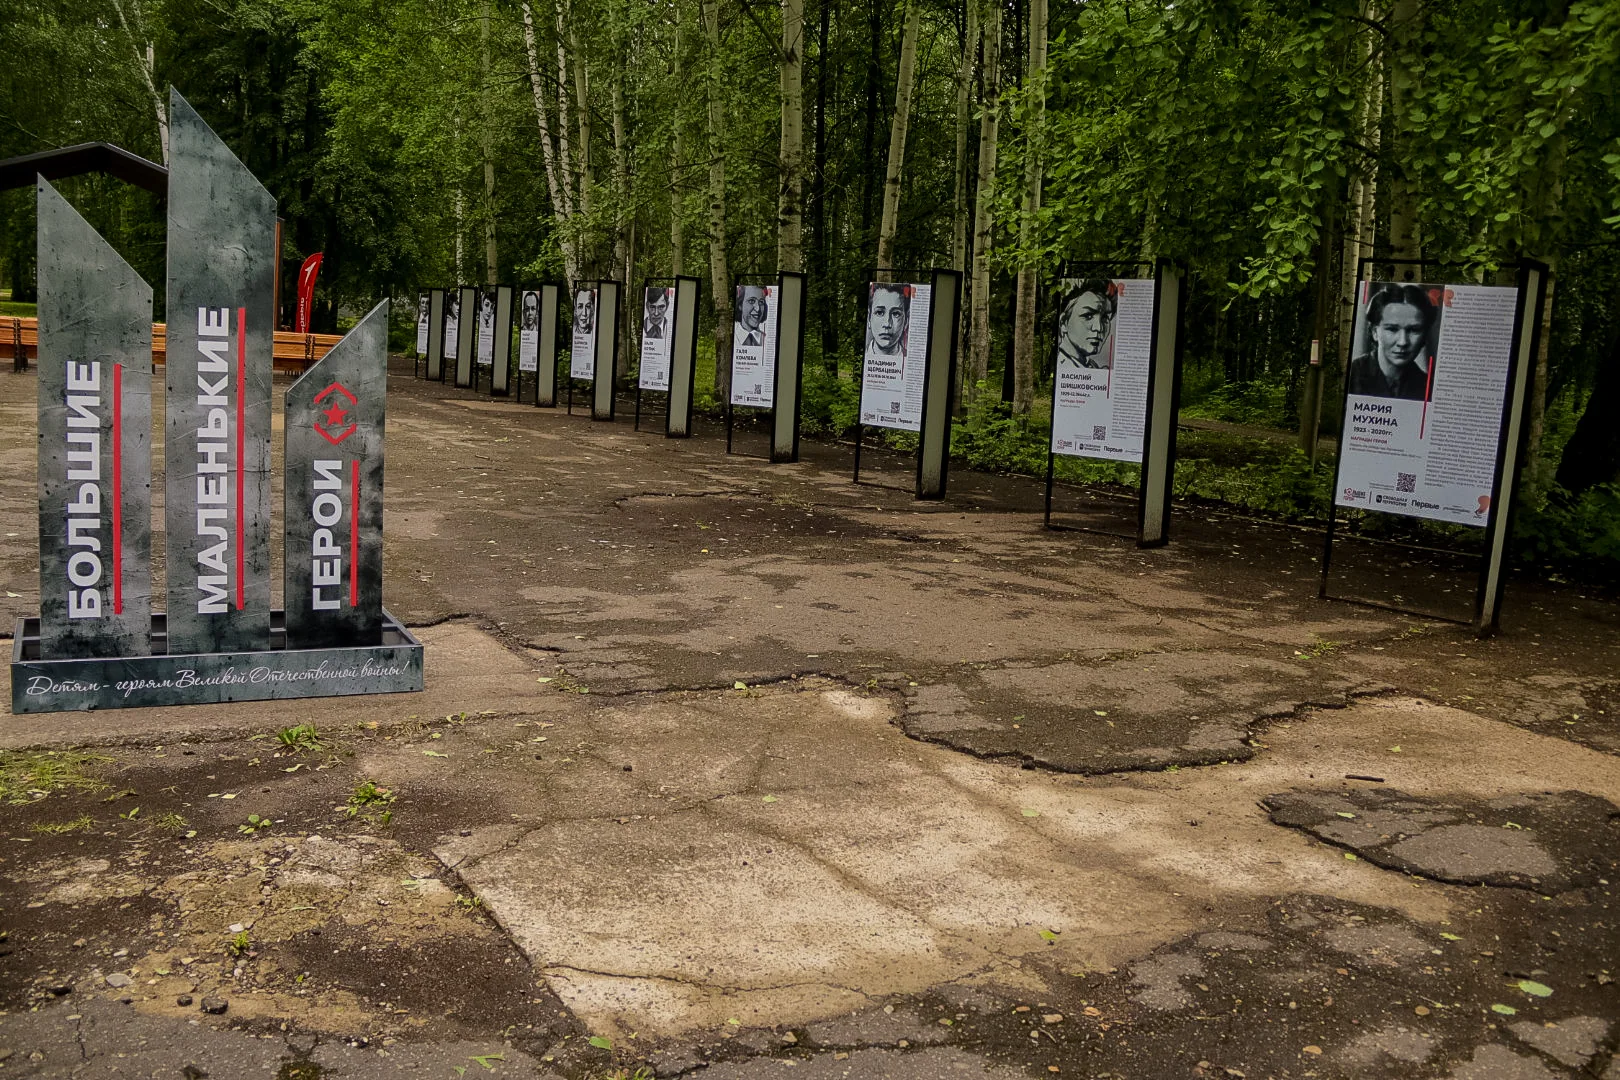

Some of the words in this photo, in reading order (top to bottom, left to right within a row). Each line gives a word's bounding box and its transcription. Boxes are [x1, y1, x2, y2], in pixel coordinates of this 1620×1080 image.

[867, 359, 897, 367] ВЛАДИМИР
[1061, 373, 1092, 382] ВАСИЛИЙ
[1060, 382, 1107, 391] ШИШКОВСКИЙ
[1353, 402, 1393, 414] МАРИЯ
[1352, 415, 1398, 427] МУХИНА
[197, 307, 229, 614] МАЛЕНЬКИЕ
[67, 360, 102, 619] БОЛЬШИЕ
[1411, 499, 1440, 510] Первые
[312, 459, 343, 610] ГЕРОИ
[26, 675, 101, 696] Детям
[115, 680, 175, 698] героям
[175, 667, 248, 689] Великой
[248, 659, 360, 684] Отечественной
[360, 657, 410, 678] войны!
